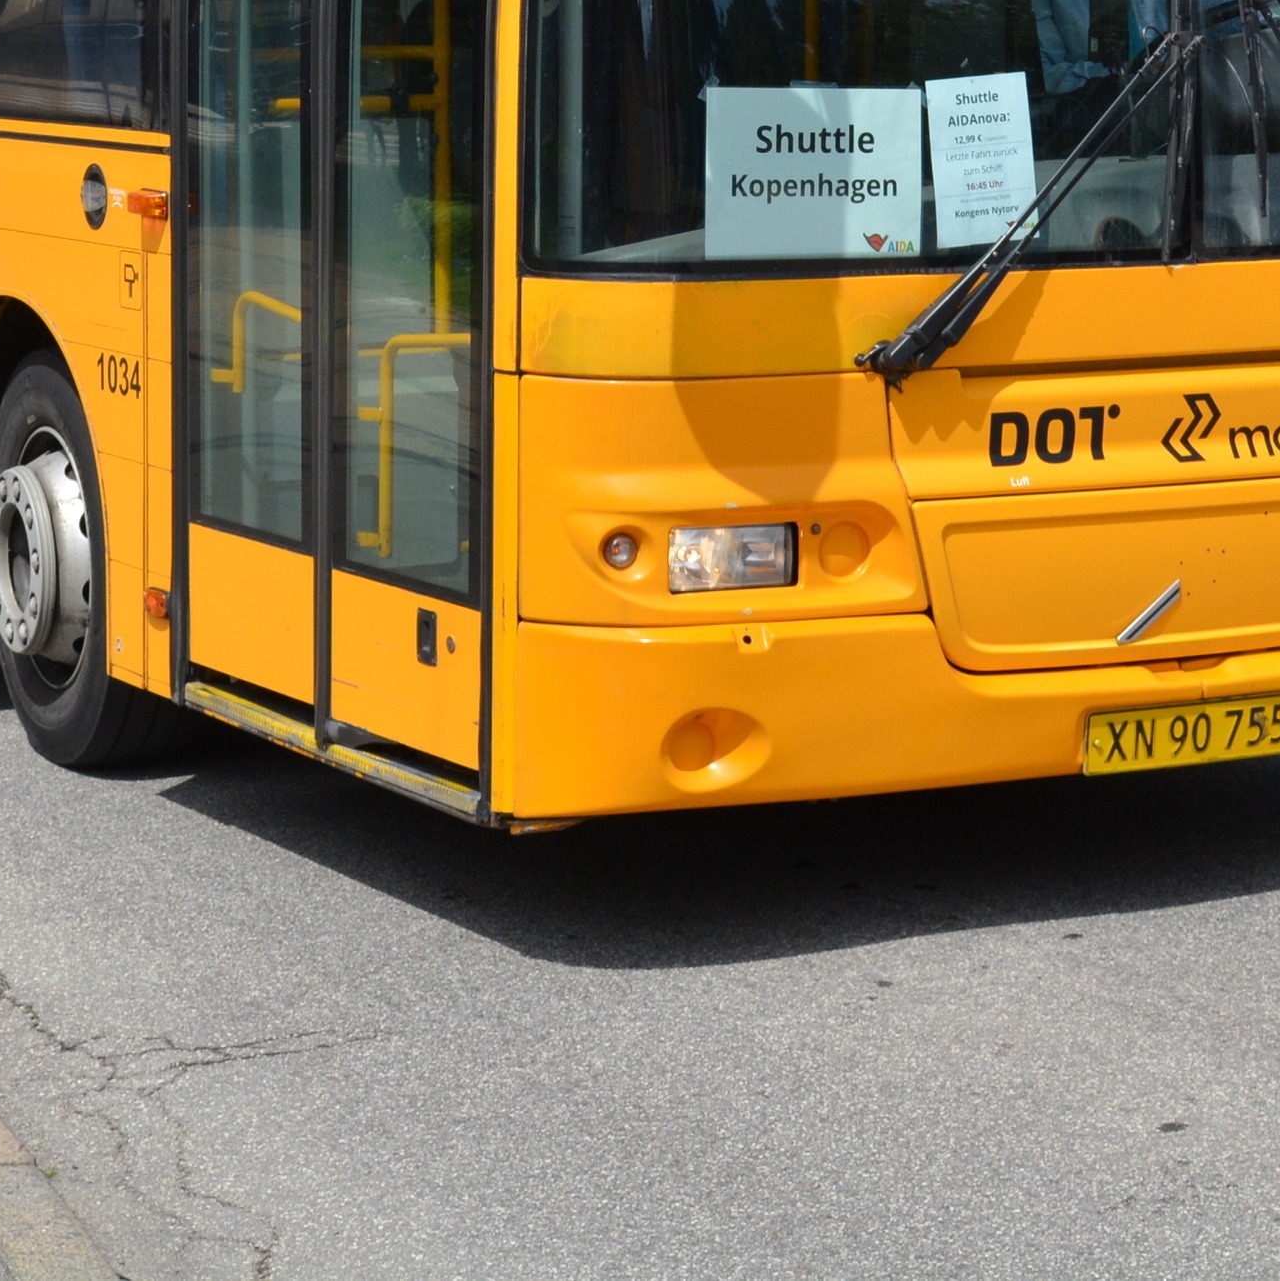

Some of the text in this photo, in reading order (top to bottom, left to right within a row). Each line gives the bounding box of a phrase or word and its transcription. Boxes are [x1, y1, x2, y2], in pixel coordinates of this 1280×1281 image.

[955, 90, 999, 105] Shuttle
[948, 112, 1010, 127] AIDAnova:
[756, 124, 875, 153] Shuttle
[955, 135, 975, 145] 12,99
[946, 147, 1018, 162] Letzte Fahrt zurück
[964, 167, 980, 176] zum
[731, 173, 898, 204] Kopenhagen
[966, 180, 1003, 191] 16:45 Uhr
[955, 205, 1019, 218] Kongens Nytorv
[888, 240, 914, 253] AIDA
[97, 352, 141, 399] 1034
[989, 404, 1121, 467] DOT
[1010, 476, 1030, 487] Luft
[1106, 719, 1155, 762] XN
[1170, 713, 1211, 756] 90
